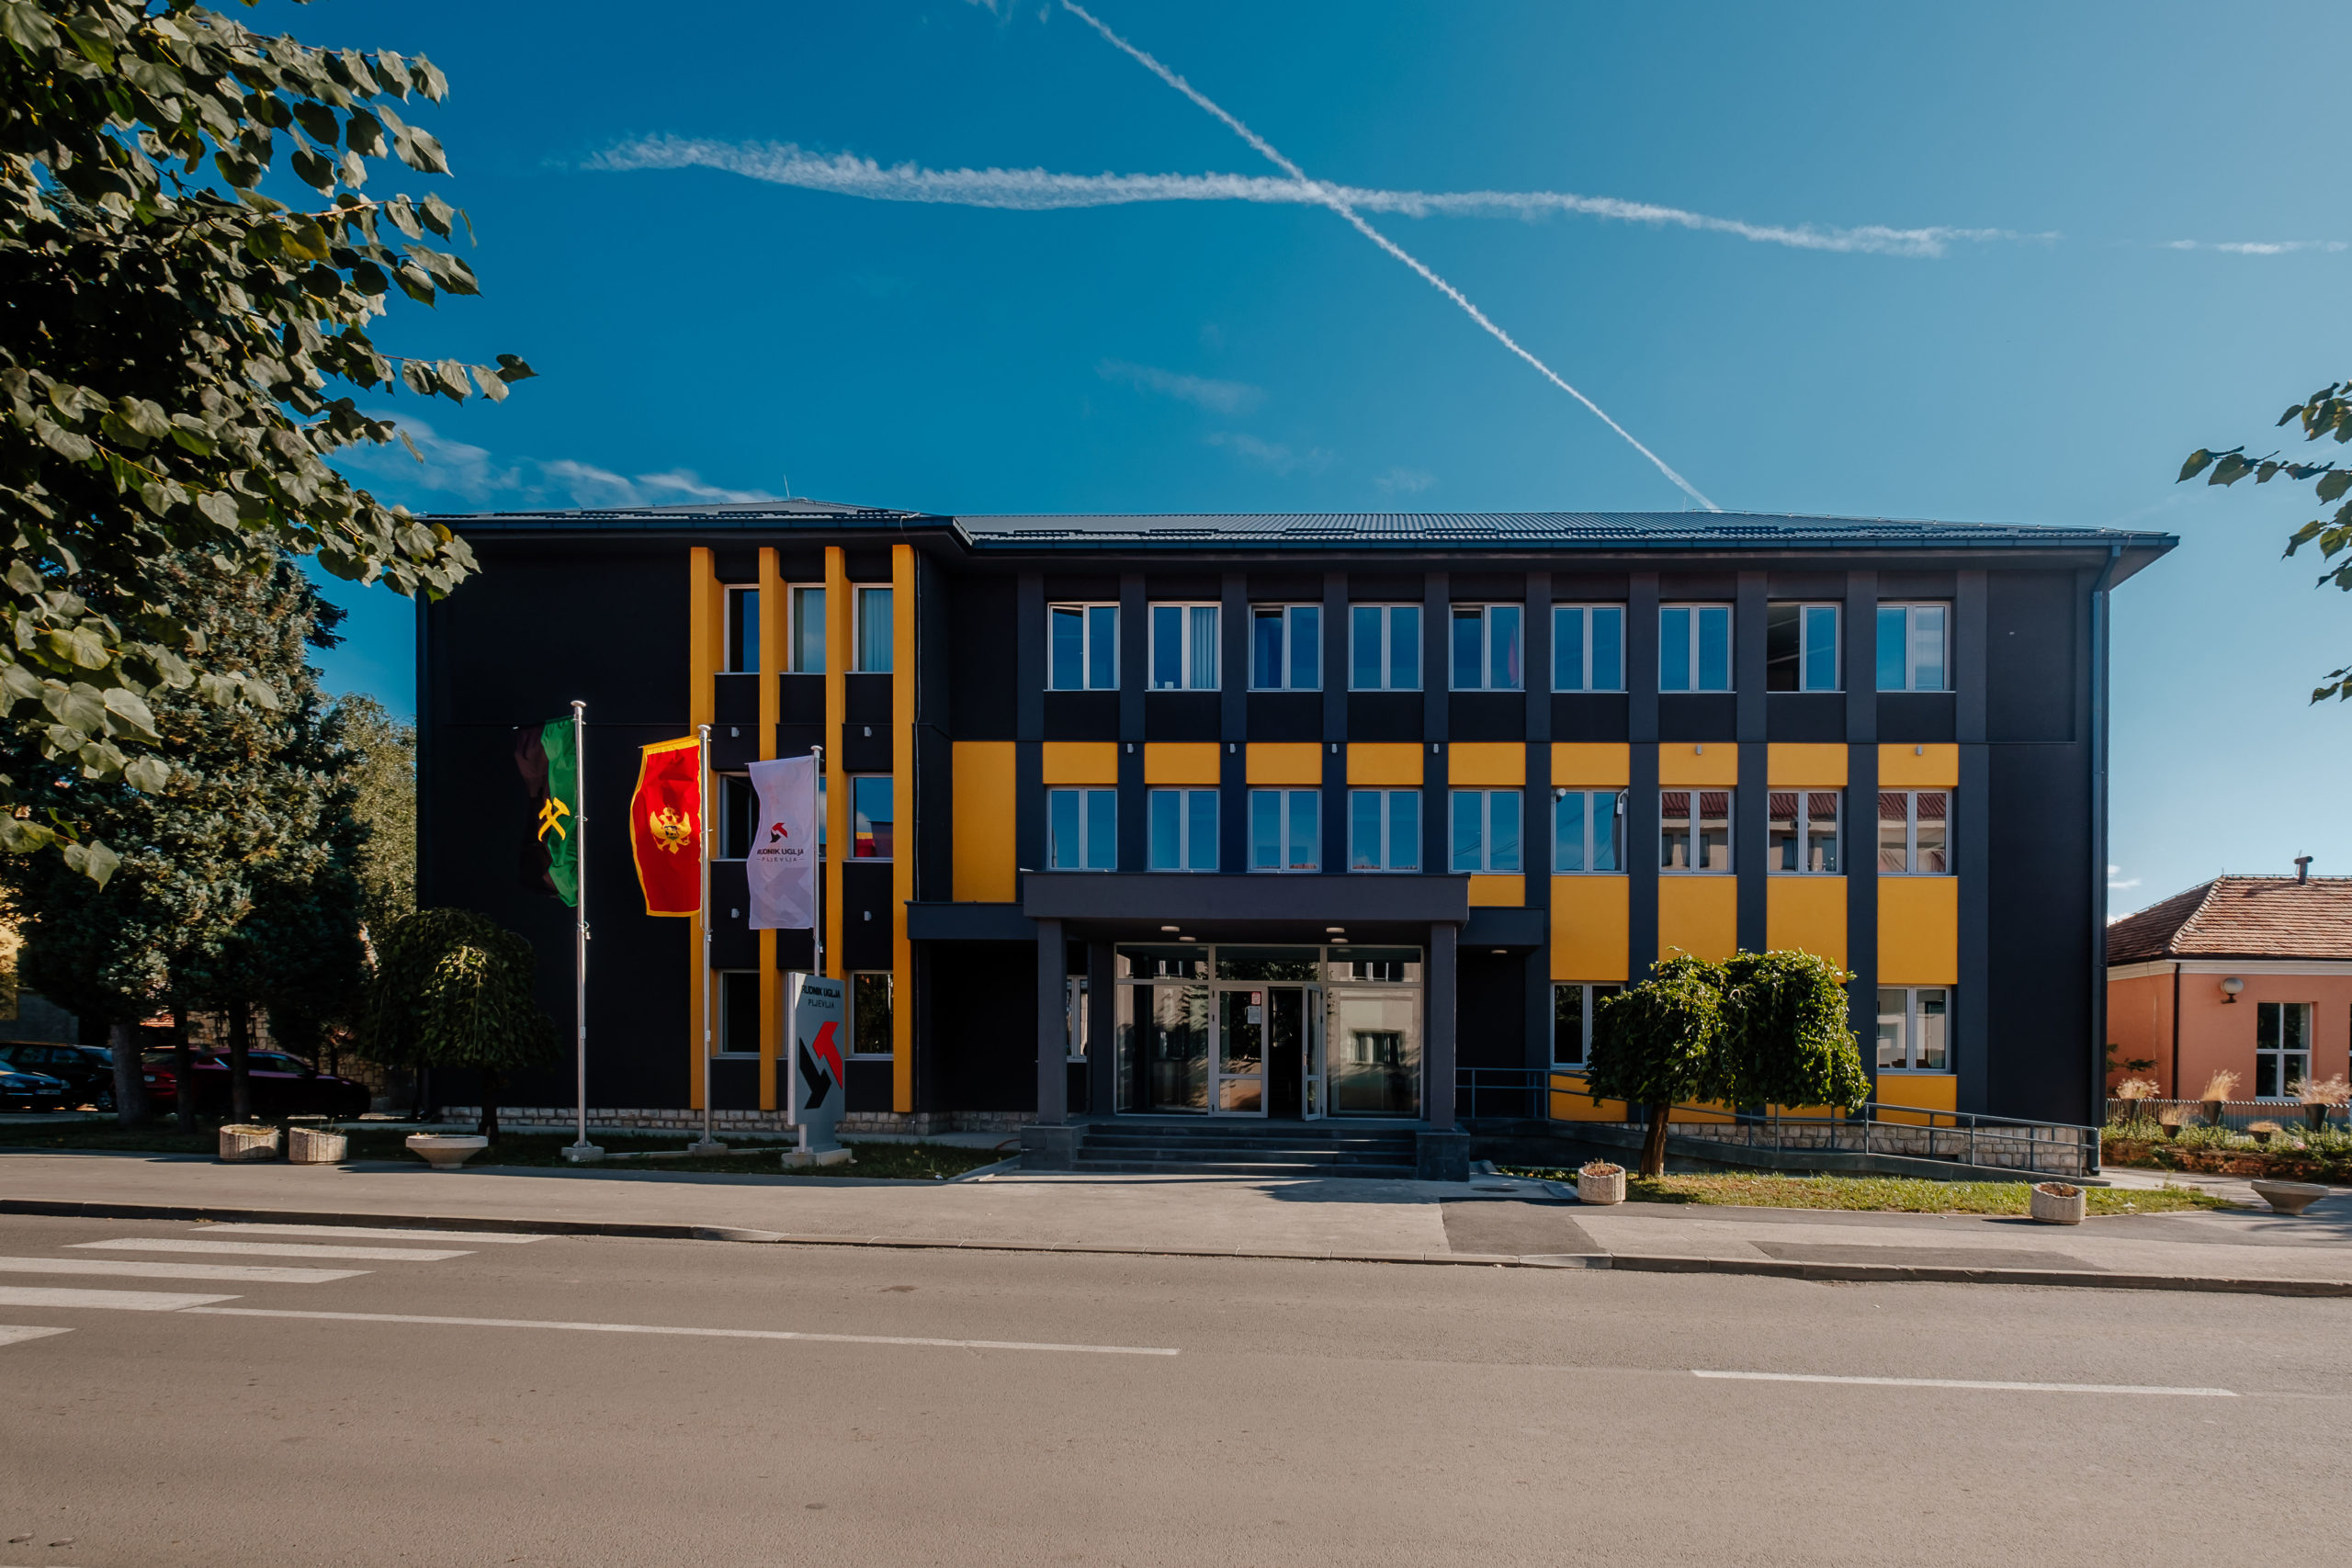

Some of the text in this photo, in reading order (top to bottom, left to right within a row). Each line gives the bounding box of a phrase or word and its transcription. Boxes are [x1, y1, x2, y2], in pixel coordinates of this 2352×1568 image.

[781, 848, 804, 856] UGLJA
[801, 984, 841, 998] RUDNIK UGLJA
[808, 998, 834, 1009] PLJEVLJA
